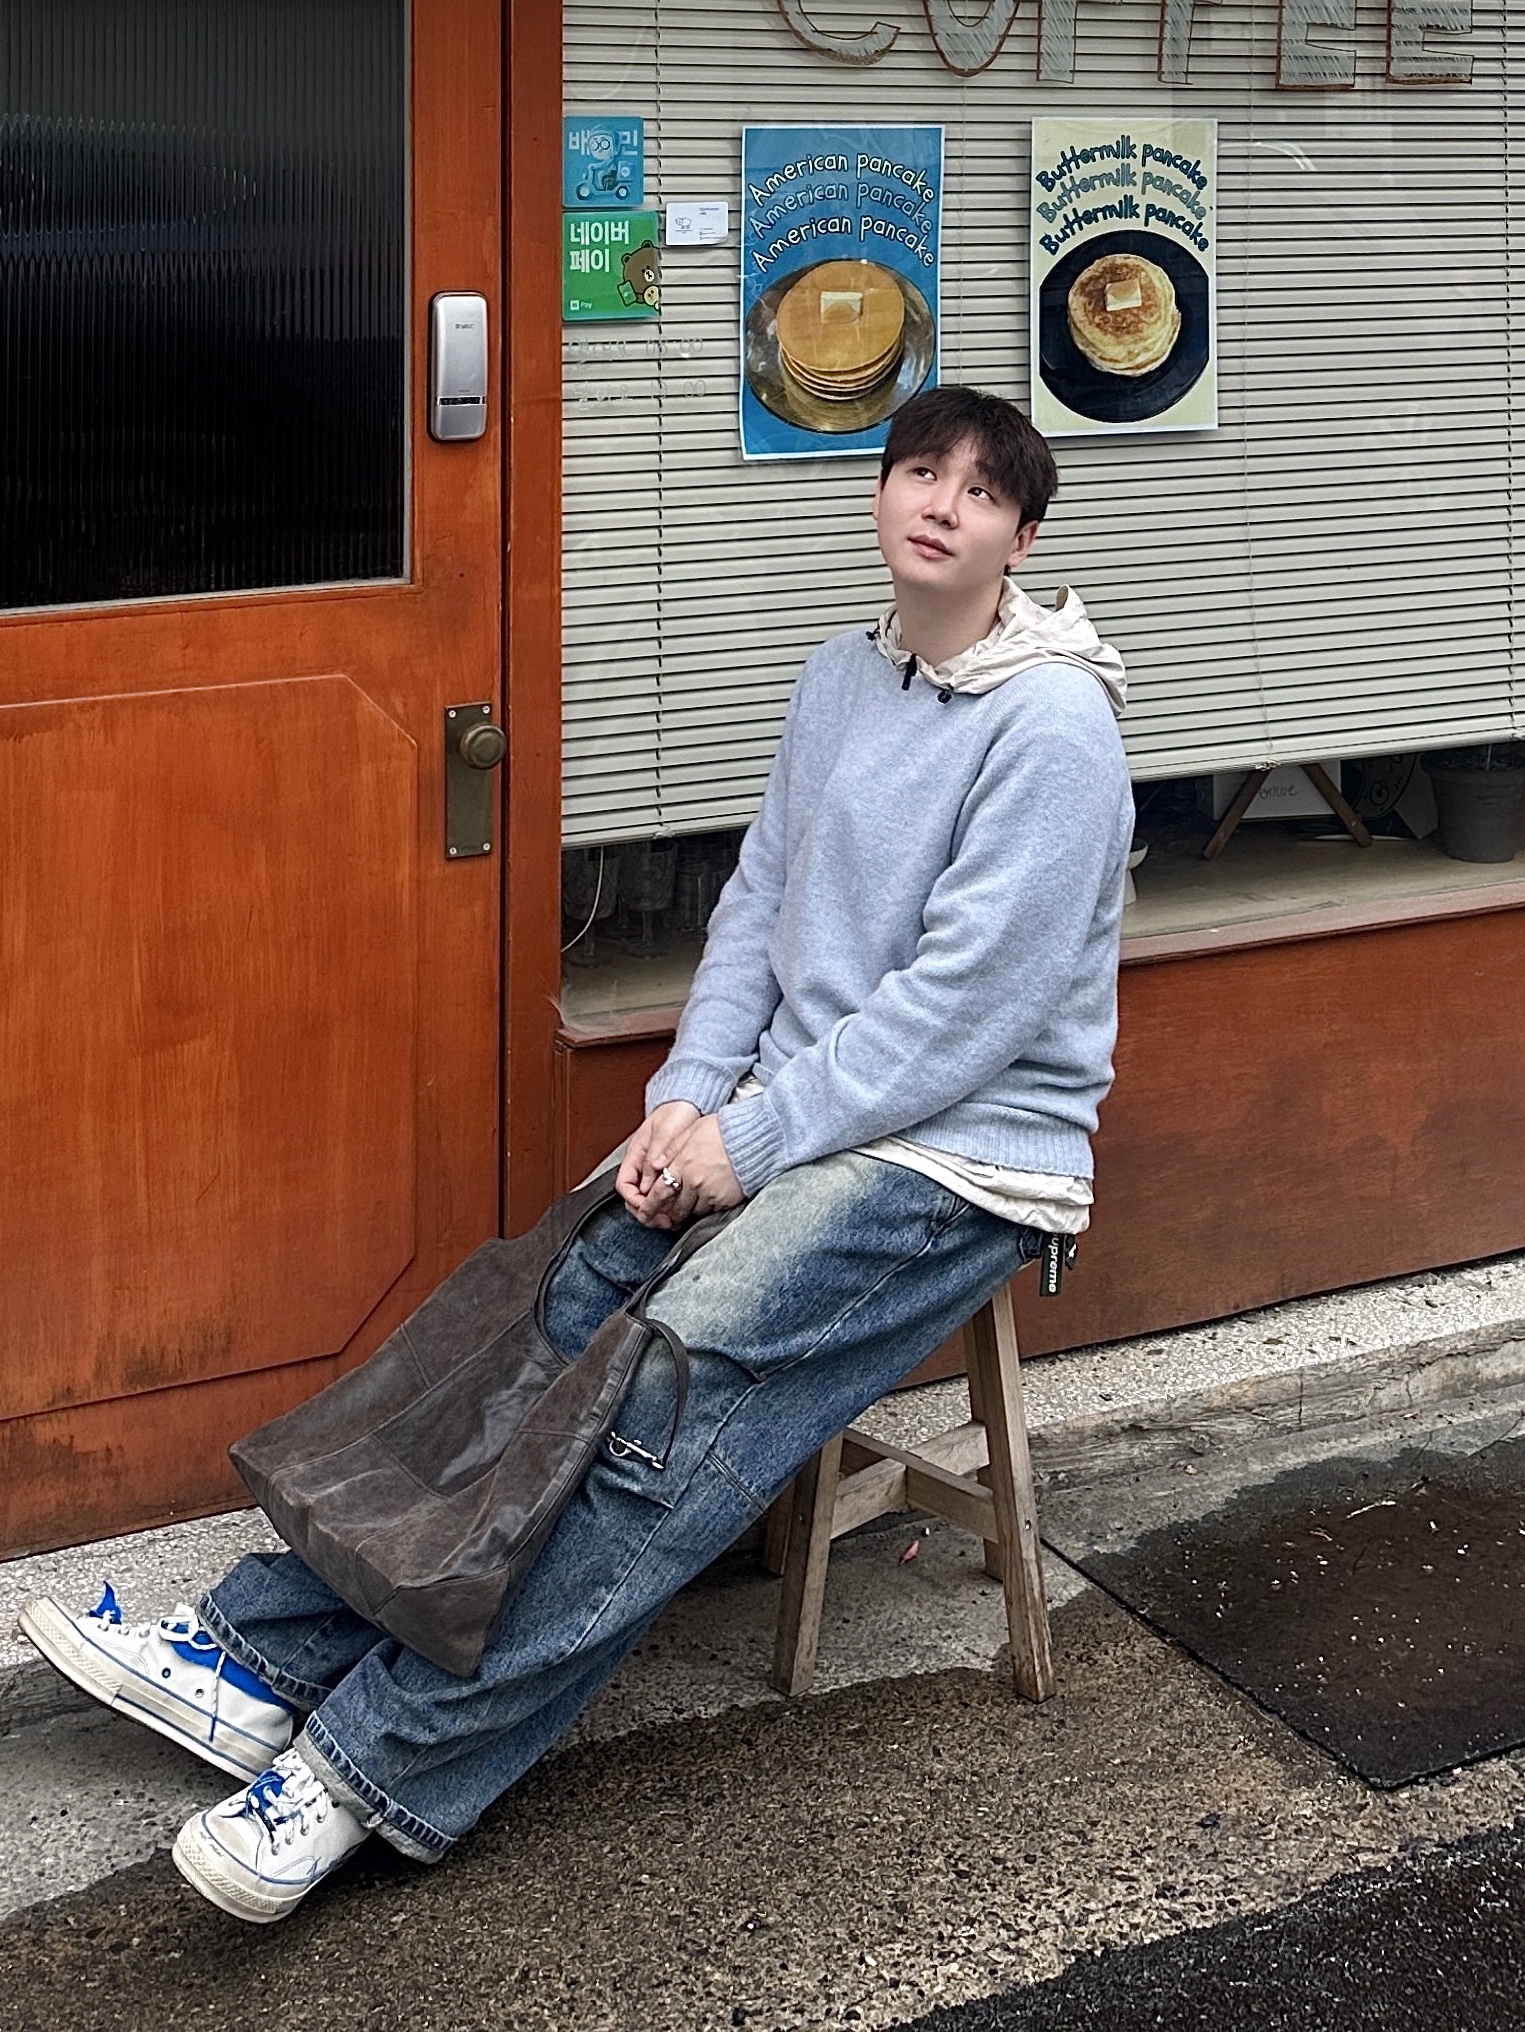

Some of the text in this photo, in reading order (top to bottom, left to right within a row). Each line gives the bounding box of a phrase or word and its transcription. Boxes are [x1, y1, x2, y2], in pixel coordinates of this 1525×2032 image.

[749, 153, 934, 207] American pancake
[1036, 135, 1207, 192] Buttermilk pancake
[749, 182, 932, 239] American pancake
[1036, 163, 1206, 223] Buttermilk pancake
[570, 220, 629, 245] 네이버
[752, 214, 934, 273] American pancake
[1039, 194, 1209, 255] Buttermilk pancake
[569, 248, 610, 273] 페이
[1047, 1233, 1060, 1293] upreme
